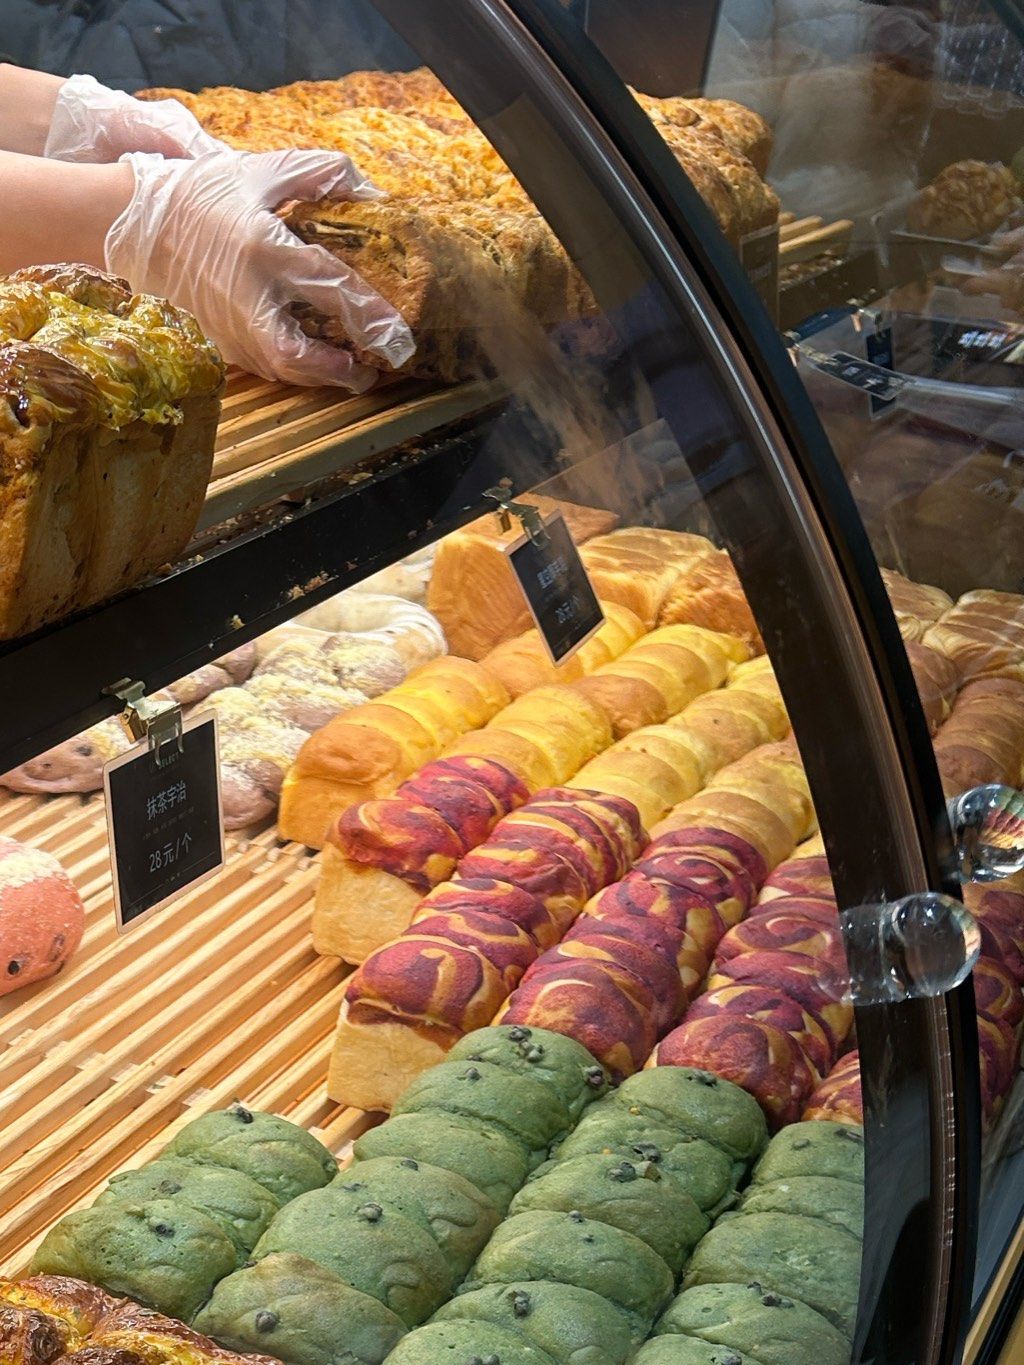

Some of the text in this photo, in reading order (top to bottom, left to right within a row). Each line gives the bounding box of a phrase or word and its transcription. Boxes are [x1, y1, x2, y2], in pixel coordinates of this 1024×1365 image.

[146, 779, 187, 822] 抹茶宇治
[149, 831, 193, 874] 28元/个
